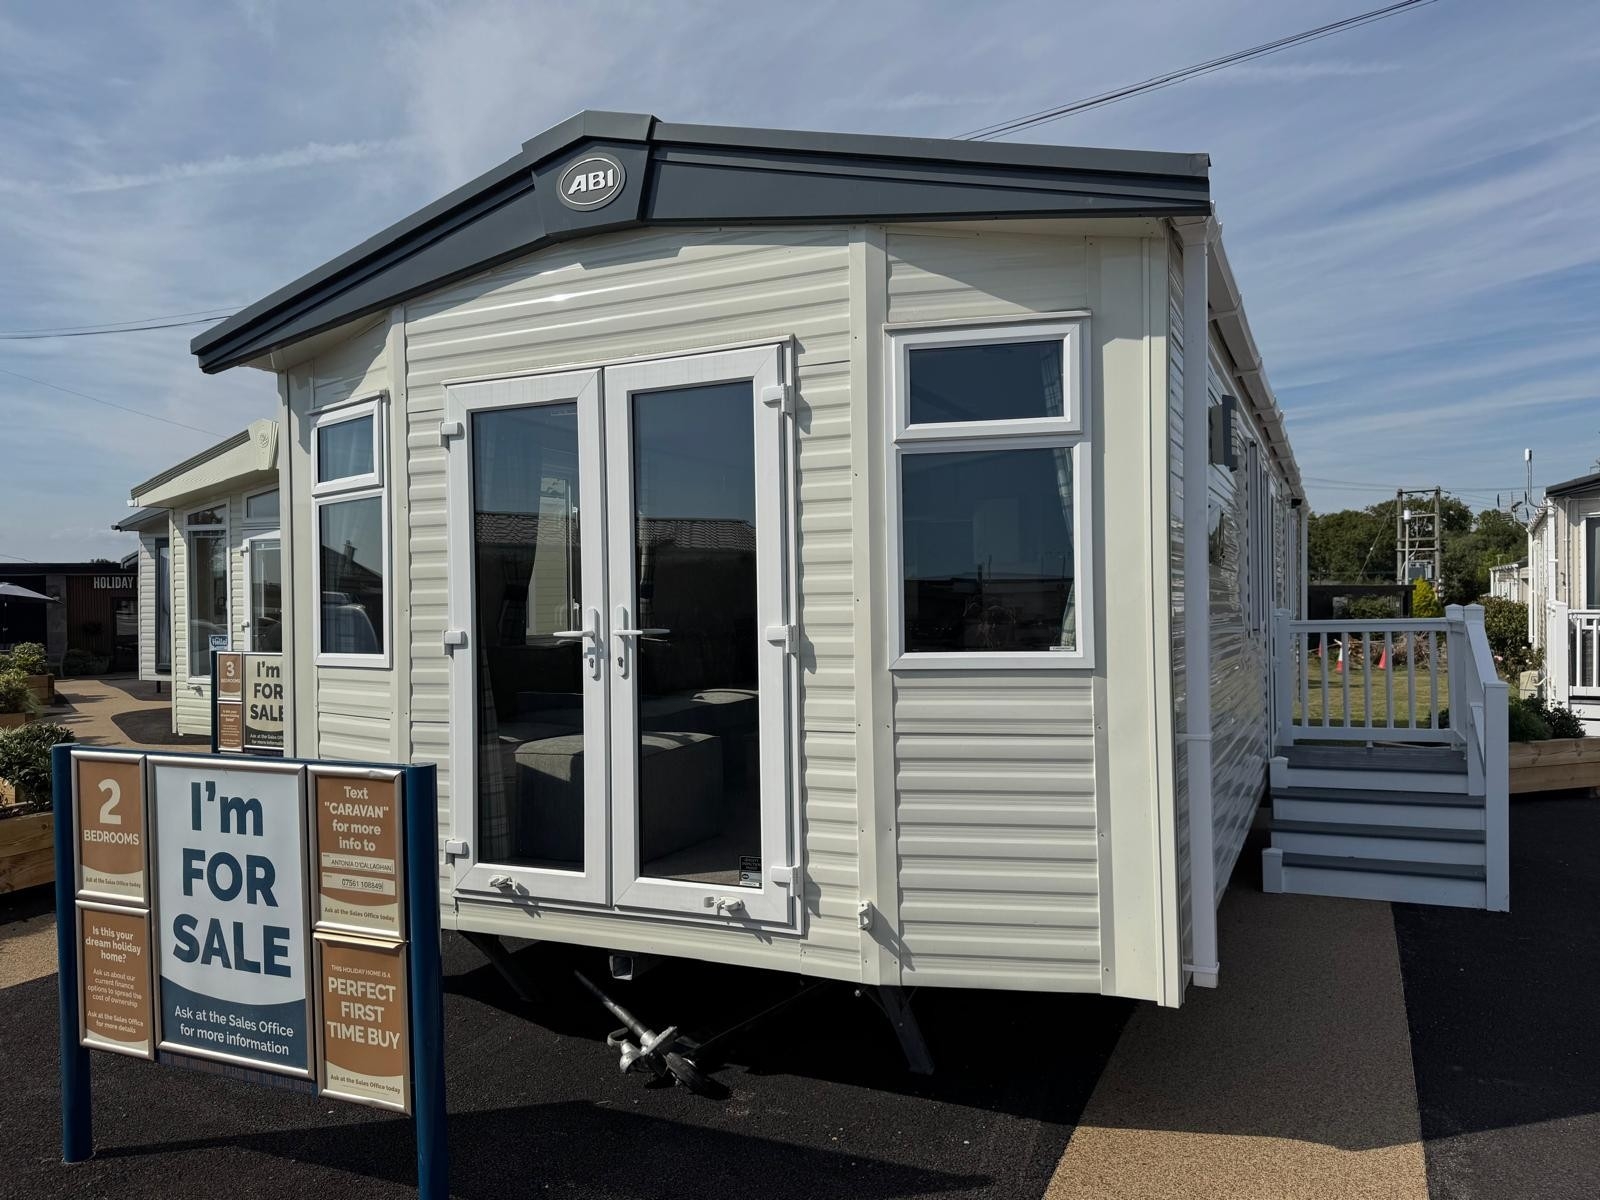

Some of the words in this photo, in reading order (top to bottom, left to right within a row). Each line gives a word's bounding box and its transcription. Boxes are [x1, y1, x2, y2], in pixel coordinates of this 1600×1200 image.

[568, 169, 613, 194] ABI
[94, 577, 133, 588] HOLIDAY
[227, 662, 234, 676] 3
[257, 661, 279, 677] I'm
[254, 683, 283, 699] FOR
[344, 786, 368, 799] Text
[99, 779, 121, 824] 2
[191, 781, 263, 836] I'm
[325, 802, 388, 818] "CARAVAN"
[333, 819, 349, 832] for
[351, 824, 381, 835] more
[84, 830, 139, 845] BEDROOMS
[339, 837, 361, 849] info
[364, 839, 375, 851] to
[183, 848, 279, 907] FOR
[93, 926, 99, 935] Is
[101, 927, 114, 937] this
[116, 932, 133, 940] your
[86, 937, 110, 948] dream
[113, 941, 141, 956] holiday
[173, 914, 291, 978] SALE
[101, 950, 126, 963] home?
[93, 968, 102, 976] Ask
[111, 972, 125, 980] about
[95, 978, 114, 986] current
[88, 985, 107, 993] options
[328, 977, 396, 1002] PERFECT
[341, 1001, 384, 1023] FIRST
[114, 1015, 127, 1023] Sales
[128, 1018, 143, 1026] Office
[175, 1005, 193, 1019] Ask
[196, 1010, 207, 1021] at
[209, 1011, 226, 1024] the
[229, 1015, 256, 1030] Sales
[259, 1021, 294, 1037] Office
[119, 1025, 136, 1033] details
[327, 1021, 365, 1043] TIME
[368, 1028, 400, 1049] BUY
[180, 1023, 194, 1036] for
[197, 1029, 224, 1042] more
[227, 1032, 289, 1055] information
[386, 1086, 400, 1094] today
